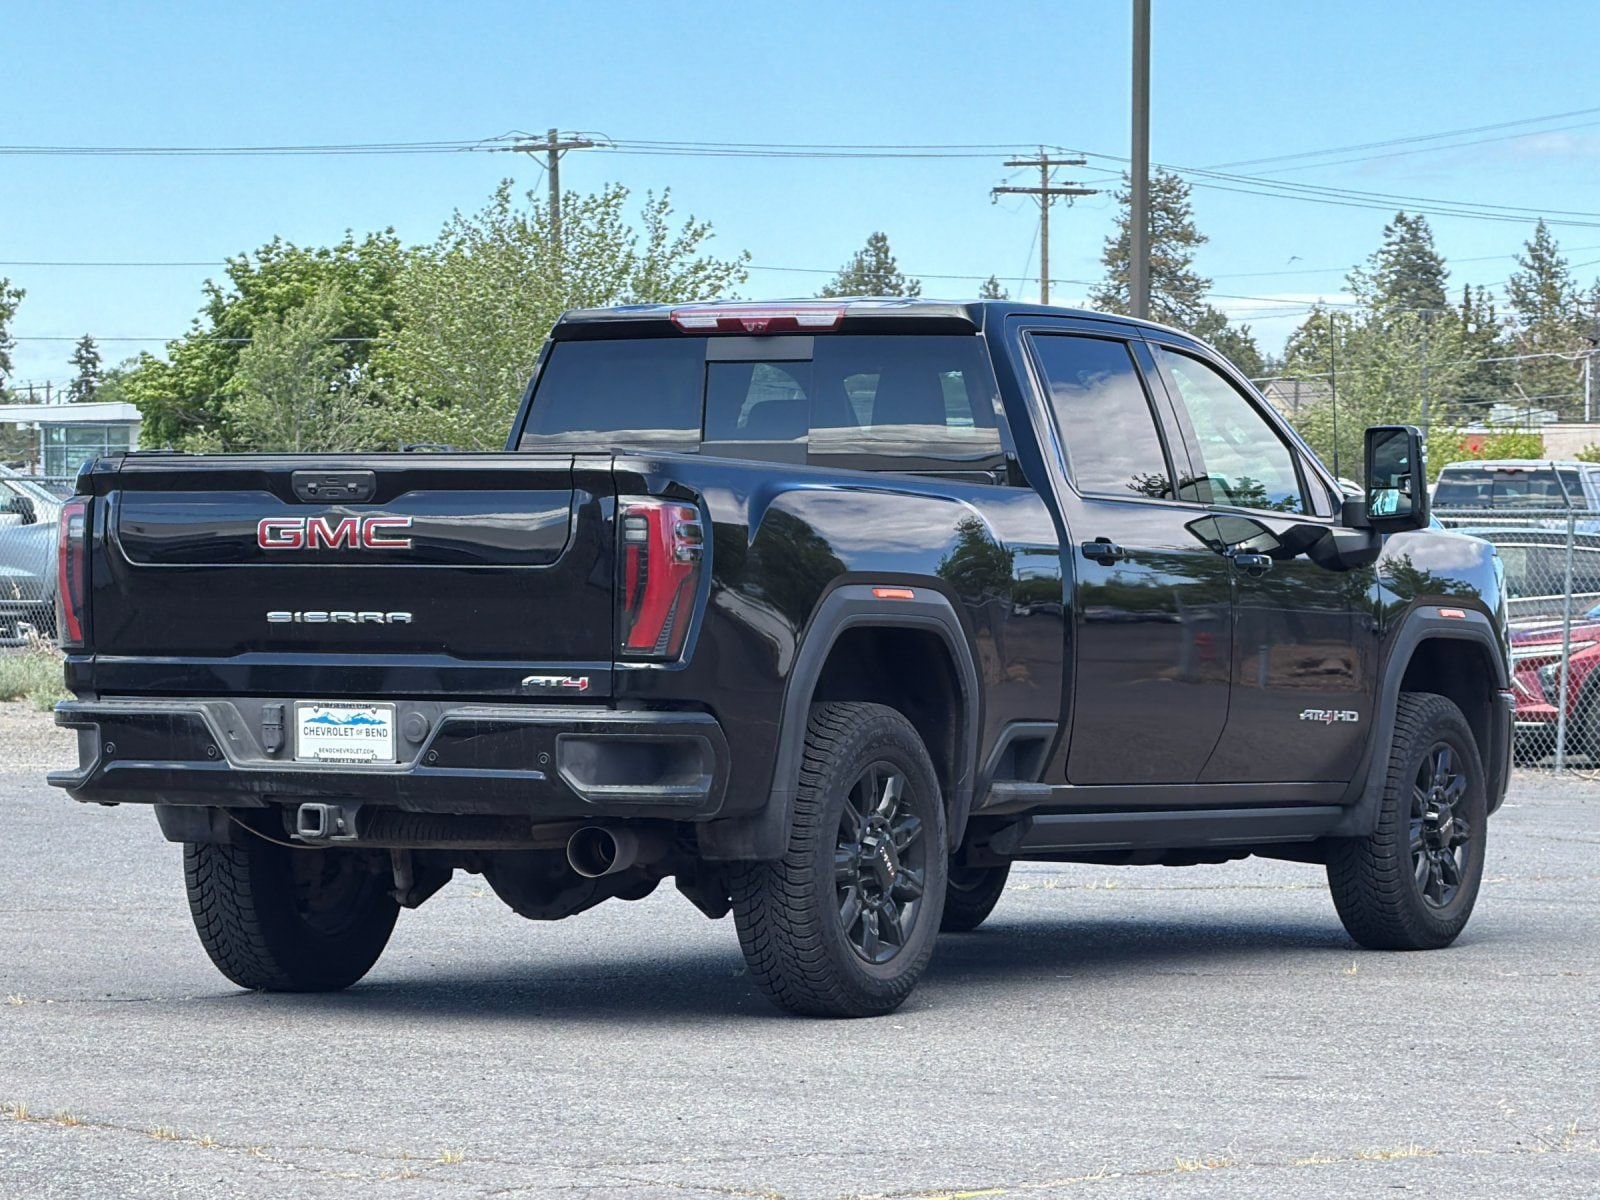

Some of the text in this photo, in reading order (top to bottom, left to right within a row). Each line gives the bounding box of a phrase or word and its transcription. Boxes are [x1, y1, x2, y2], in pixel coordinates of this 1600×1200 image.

[257, 516, 413, 550] GMC
[266, 611, 413, 624] SIERRA
[521, 675, 589, 691] AT4
[303, 726, 354, 737] CHEVROLET
[365, 728, 388, 738] BEND
[318, 747, 375, 755] BENDCHEVROLET.COM
